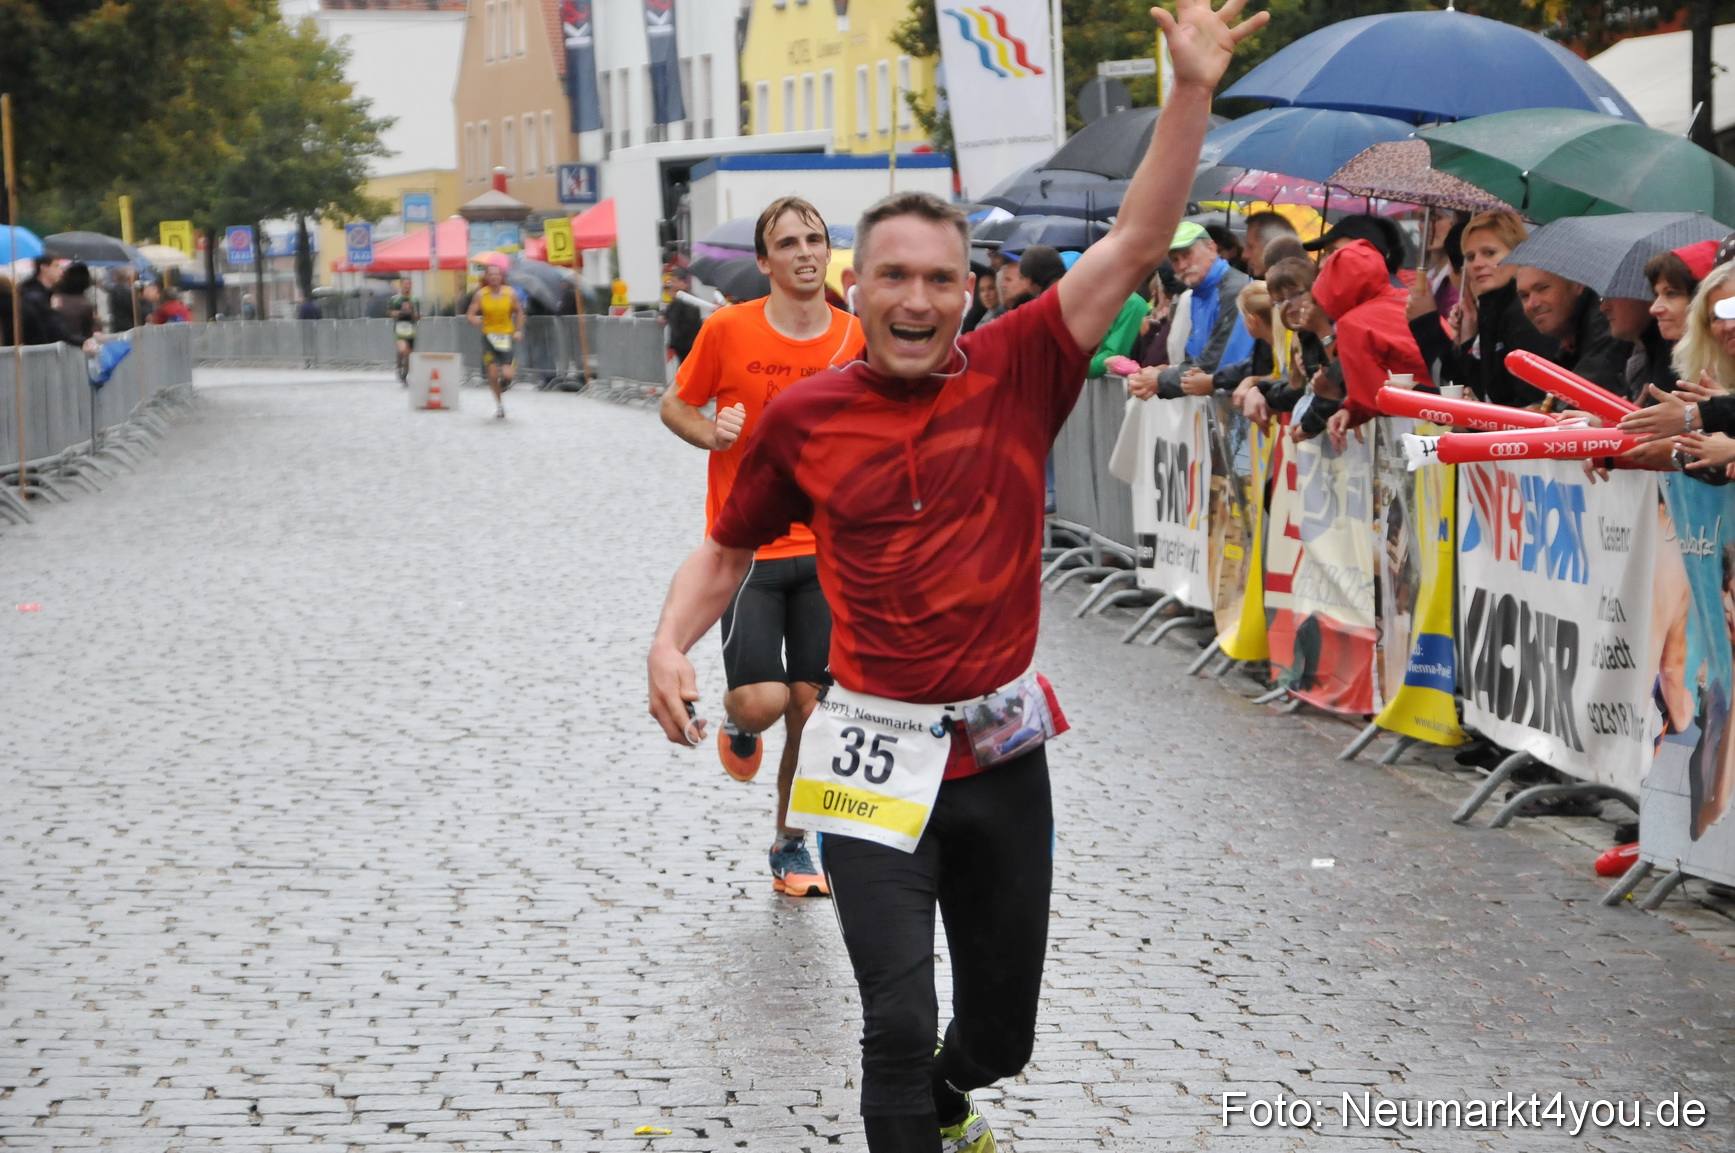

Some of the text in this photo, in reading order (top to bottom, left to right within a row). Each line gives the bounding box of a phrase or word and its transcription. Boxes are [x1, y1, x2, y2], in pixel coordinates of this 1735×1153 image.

[552, 232, 567, 251] D
[1467, 417, 1498, 431] BKK
[1543, 439, 1623, 453] Audi BKK
[853, 708, 924, 733] Neumarkt
[831, 726, 899, 785] 35
[823, 789, 879, 819] Oliver
